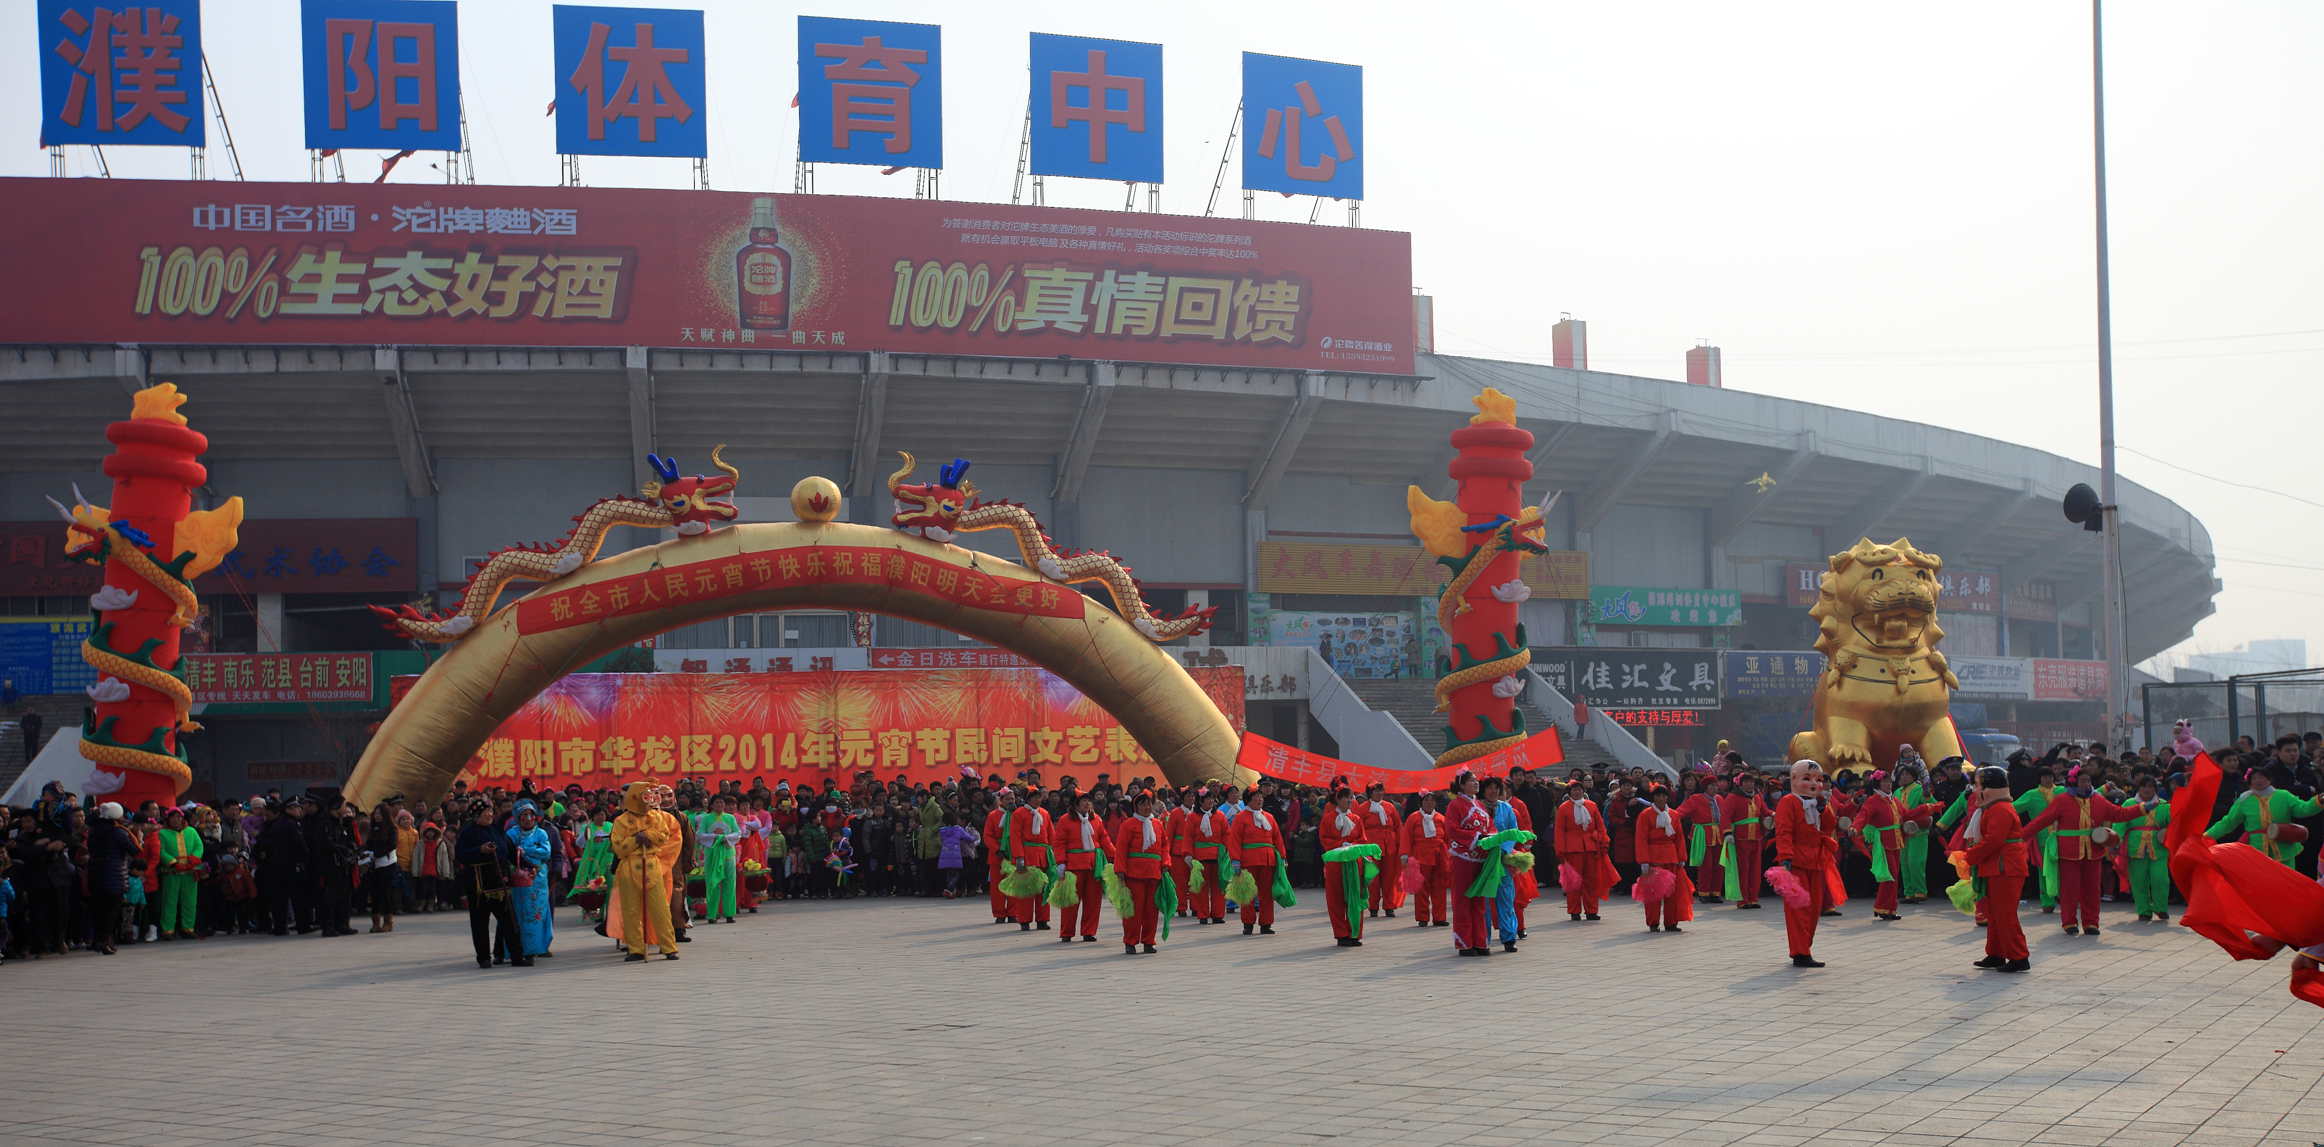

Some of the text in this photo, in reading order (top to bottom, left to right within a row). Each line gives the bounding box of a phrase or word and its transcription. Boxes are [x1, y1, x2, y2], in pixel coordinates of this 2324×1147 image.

[135, 246, 623, 319] 100%生态好酒
[888, 259, 1301, 344] 100%真情回馈
[550, 549, 1061, 622] 祝全市人民元宵节快乐祝福濮阳明天会更好
[184, 657, 367, 690] 清丰 南乐 范县 台前 安阳
[896, 651, 977, 667] 金日洗车
[1581, 661, 1715, 692] 佳汇文具
[477, 726, 1152, 777] 濮阳市华龙区2014年元宵节民间文艺表
